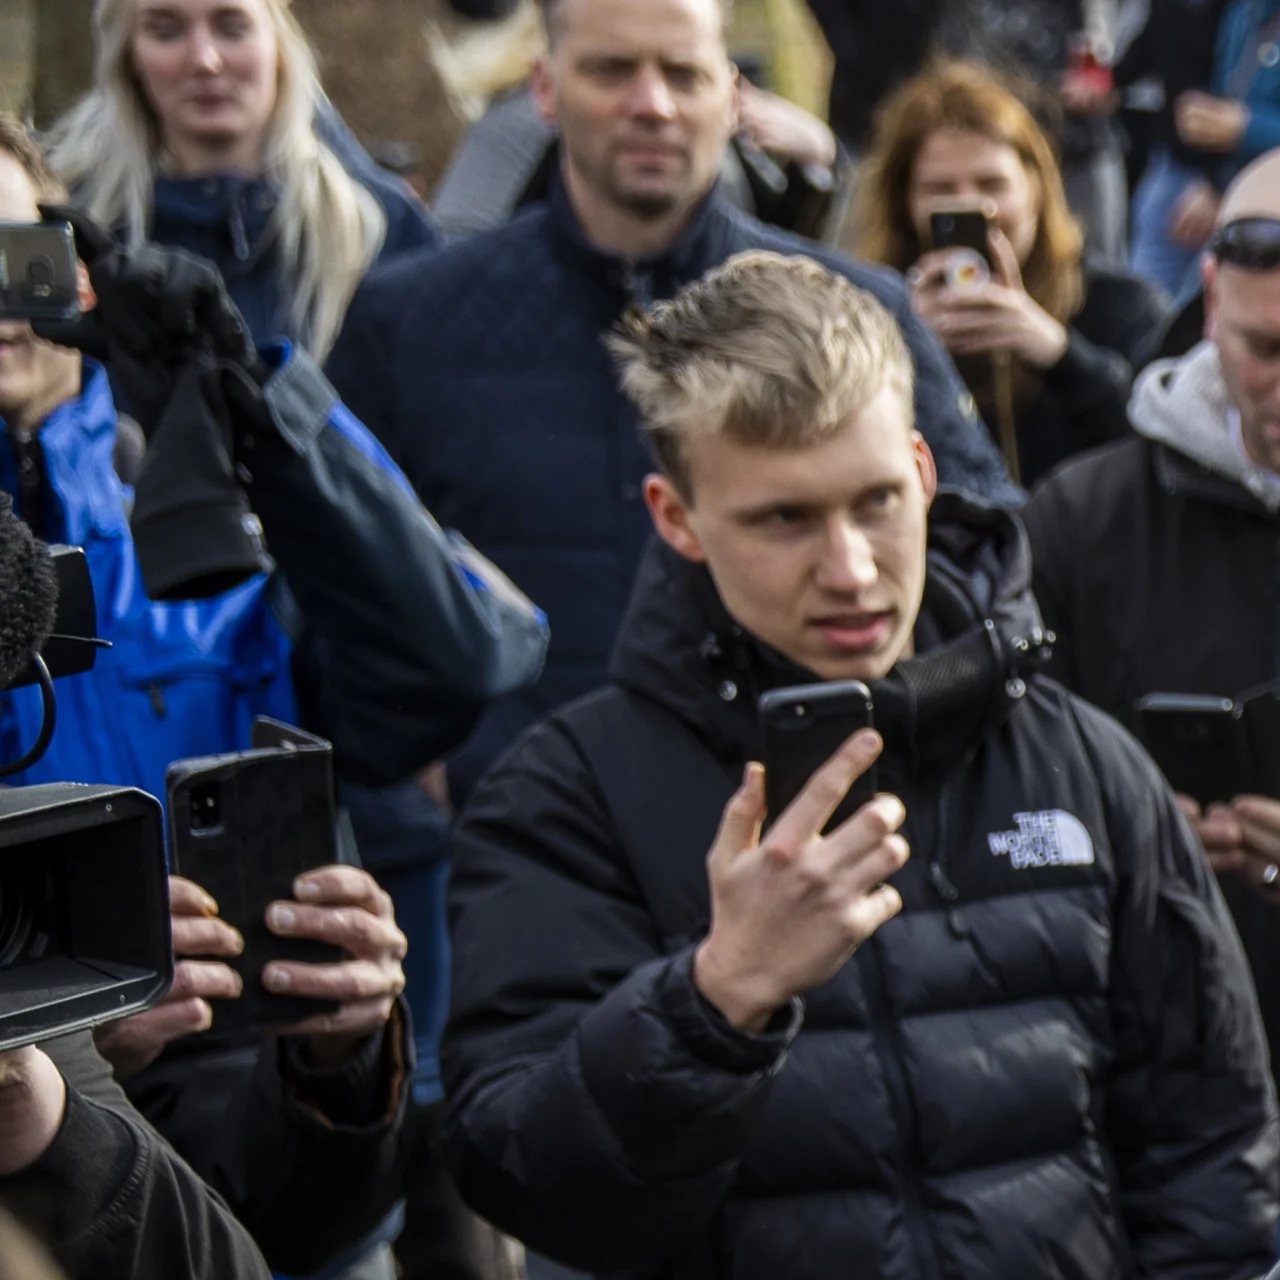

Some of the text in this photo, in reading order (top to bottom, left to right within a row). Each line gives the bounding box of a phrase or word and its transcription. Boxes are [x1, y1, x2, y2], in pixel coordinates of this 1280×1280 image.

[1013, 811, 1056, 832] THE
[988, 831, 1059, 855] NORTH
[1010, 849, 1062, 868] FACE
